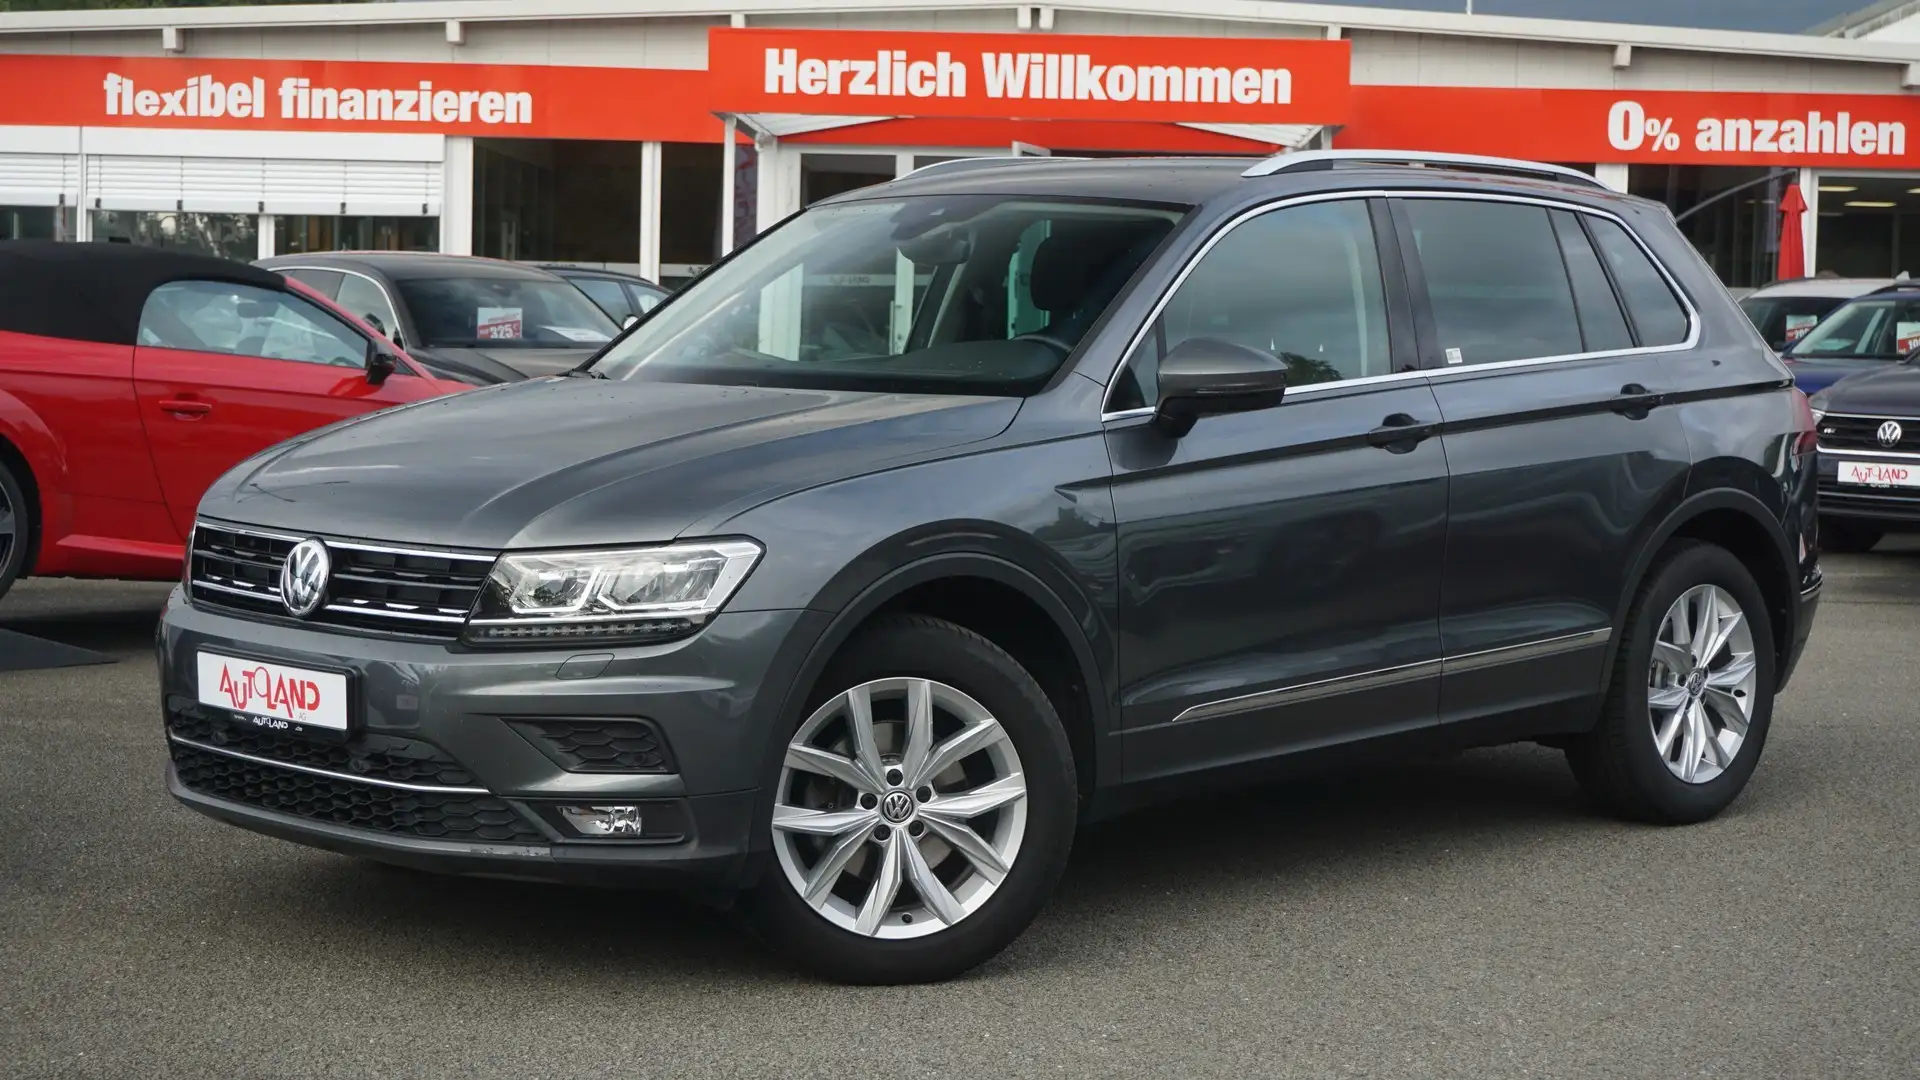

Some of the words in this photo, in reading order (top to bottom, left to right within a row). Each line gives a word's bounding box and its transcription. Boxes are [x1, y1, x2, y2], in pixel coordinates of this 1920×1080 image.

[104, 72, 265, 119] flexibel
[279, 77, 533, 124] finanzieren
[765, 48, 967, 99] Herzlich
[982, 52, 1292, 105] Willkommen
[1608, 100, 1680, 152] 0%
[1695, 112, 1906, 155] anzahlen
[1852, 466, 1908, 484] AUTOLAND
[219, 662, 321, 719] AUTOLAND
[253, 716, 289, 730] AUTOLAND
